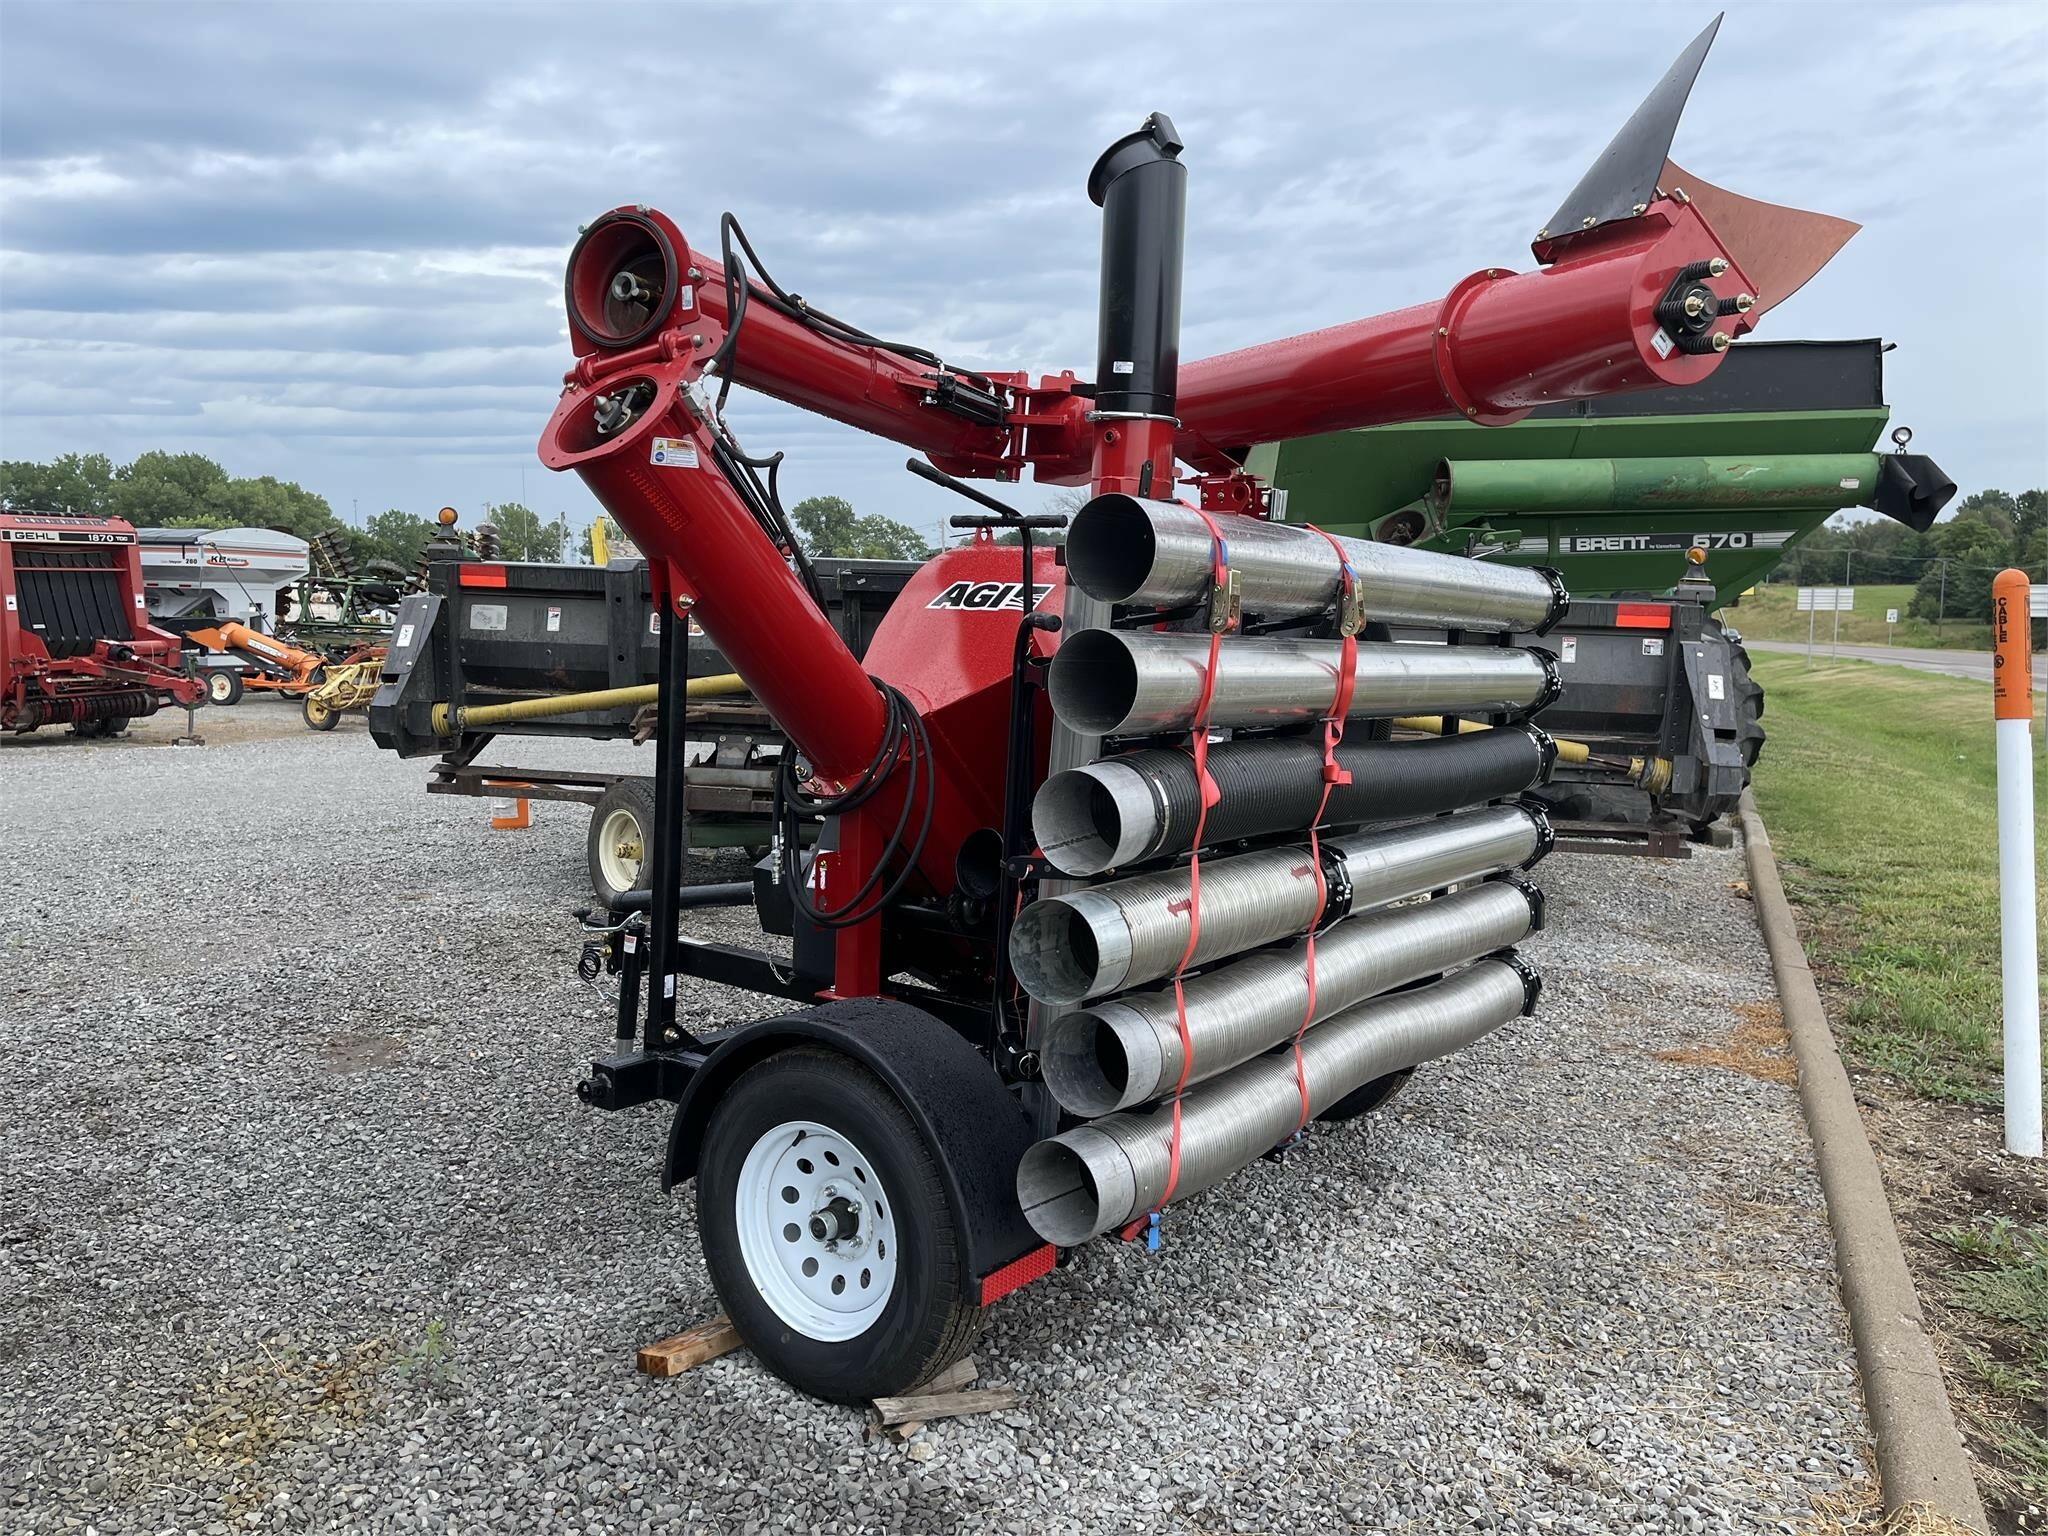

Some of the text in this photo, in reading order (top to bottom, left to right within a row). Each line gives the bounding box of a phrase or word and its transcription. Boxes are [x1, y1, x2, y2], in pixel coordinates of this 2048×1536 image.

[15, 532, 55, 540] GEHL
[88, 534, 114, 542] 1870
[1576, 536, 1650, 551] BRENT
[1693, 533, 1747, 549] 670
[930, 583, 1016, 608] AGI
[1998, 597, 2007, 643] CABLE
